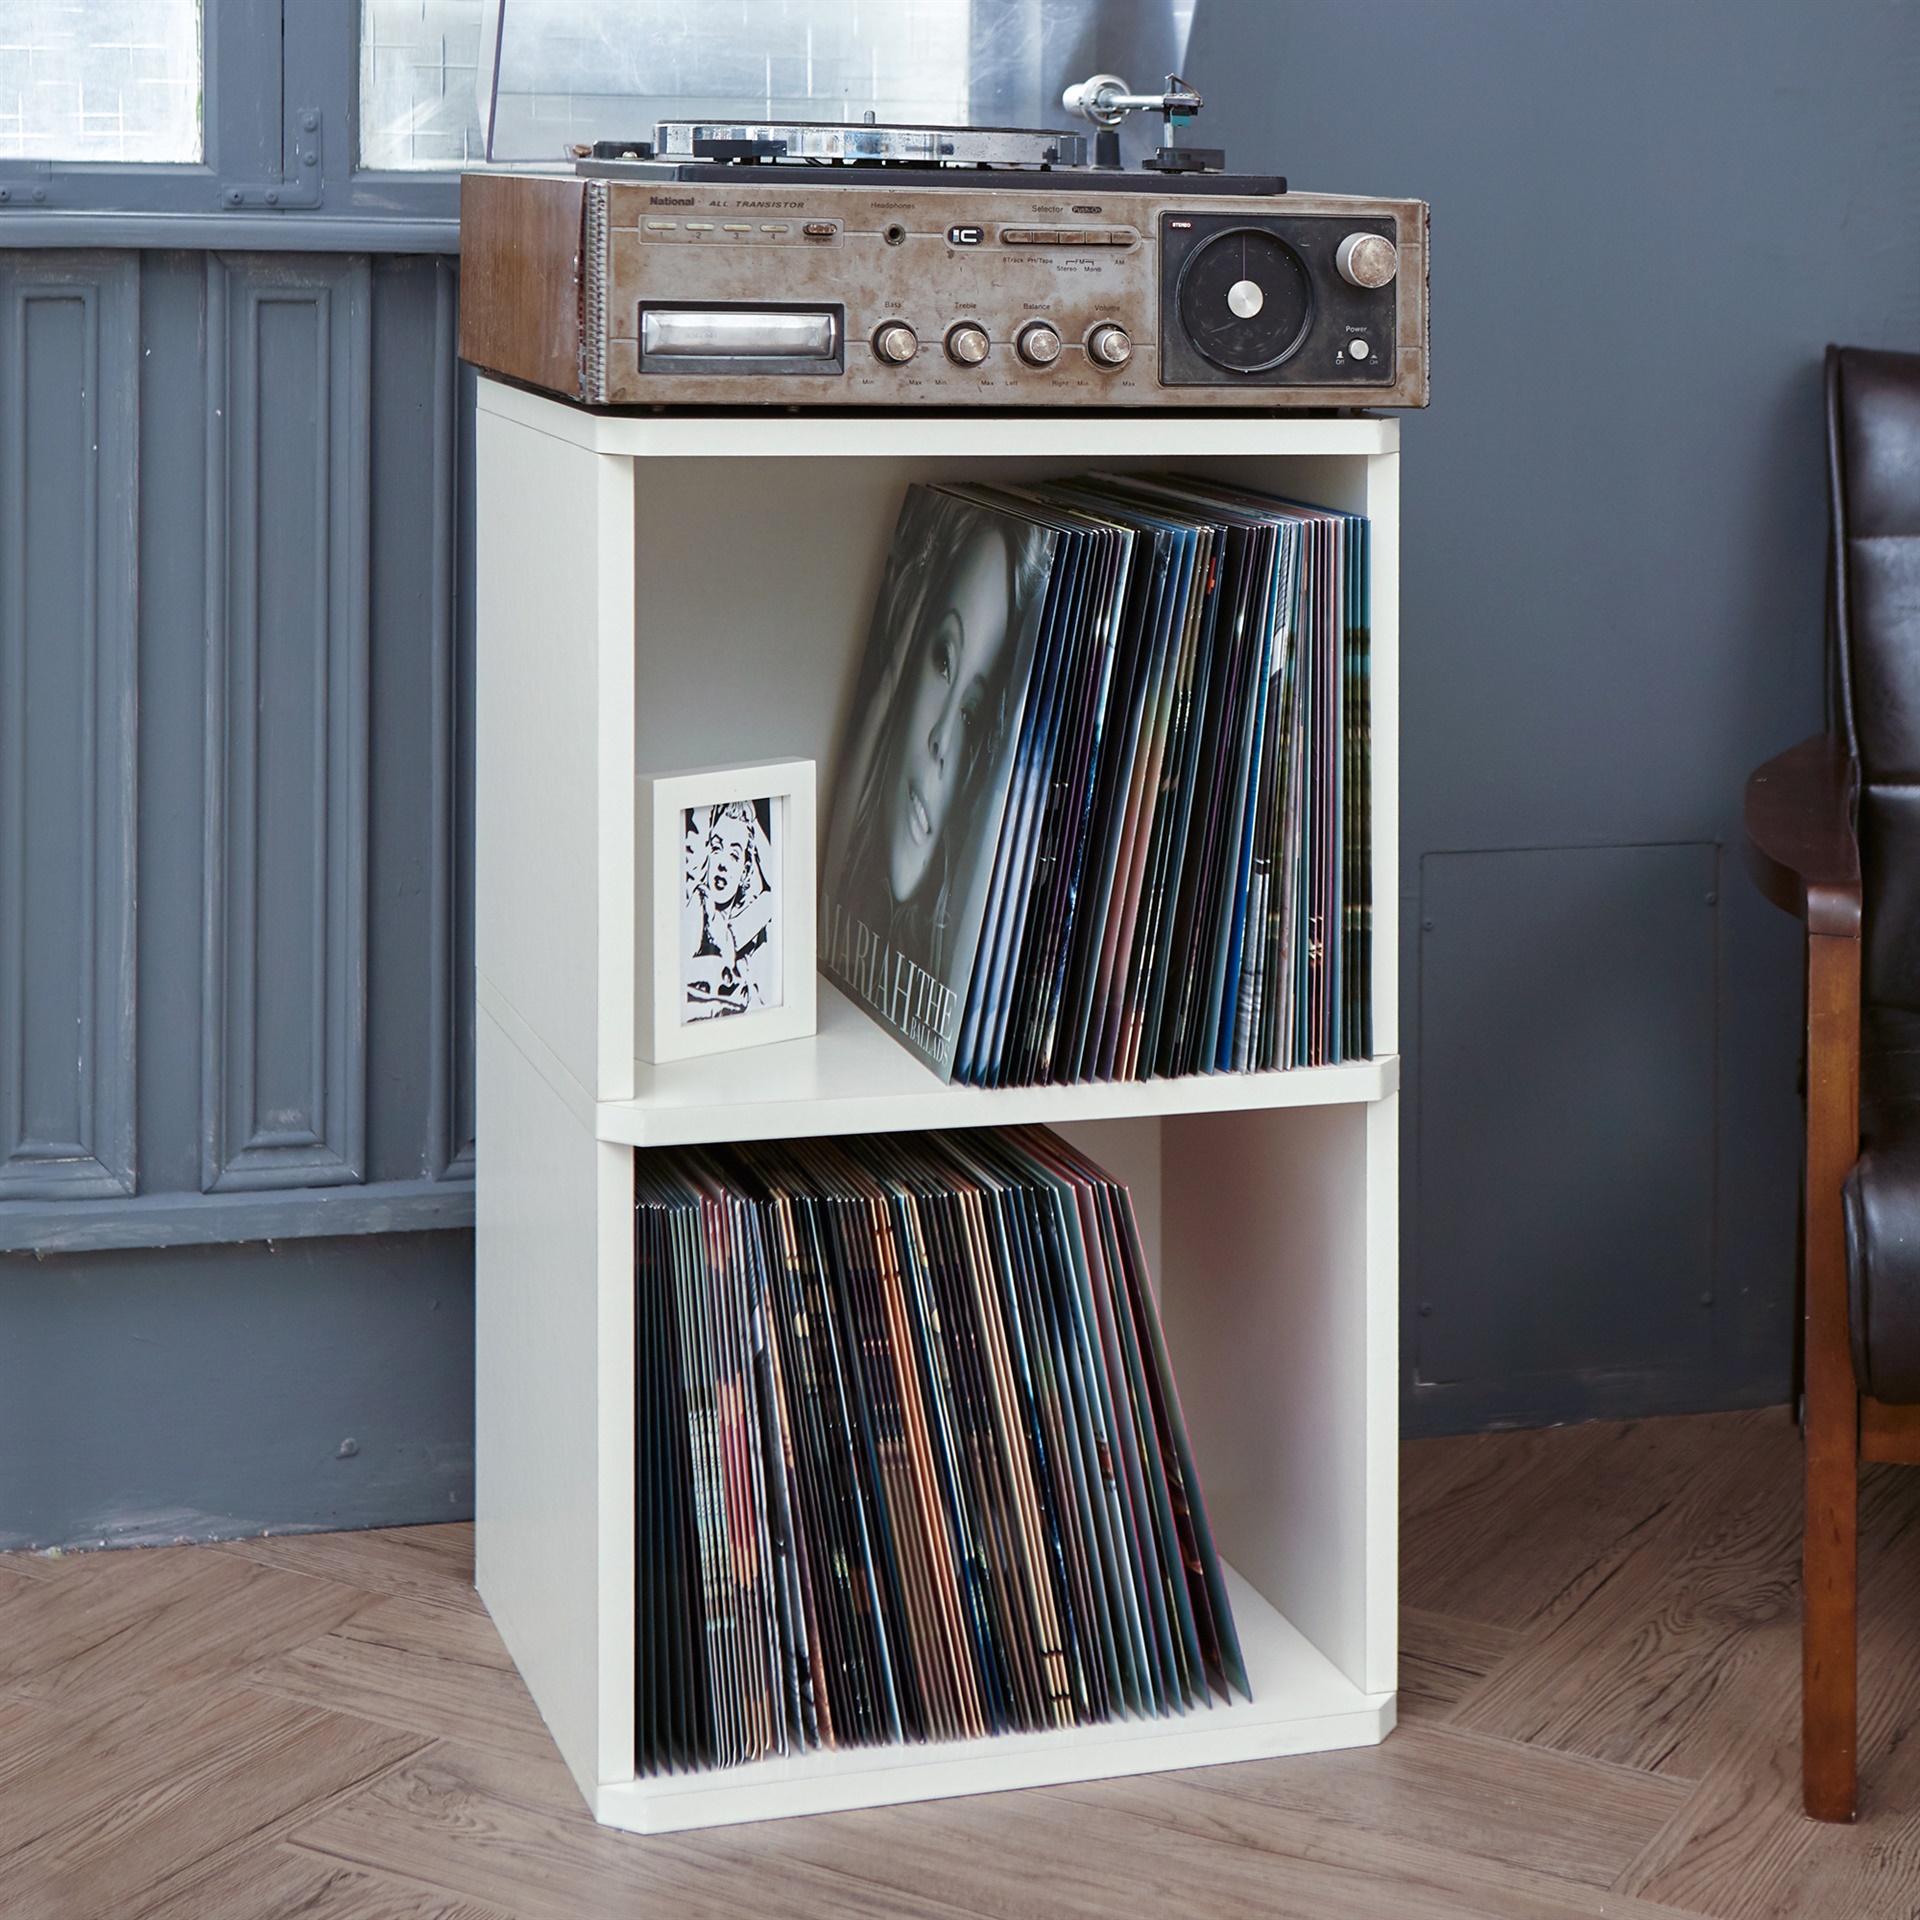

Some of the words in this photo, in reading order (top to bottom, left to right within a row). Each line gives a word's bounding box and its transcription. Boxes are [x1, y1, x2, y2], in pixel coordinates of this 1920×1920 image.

[650, 196, 695, 206] National
[736, 201, 805, 209] TRANSISTOR
[871, 202, 915, 210] Headphones
[1031, 205, 1063, 213] Selector
[733, 232, 740, 240] 3
[1094, 304, 1121, 312] Volume
[1345, 325, 1367, 333] Power
[915, 967, 958, 1042] THE
[909, 1016, 951, 1067] BALLADS
